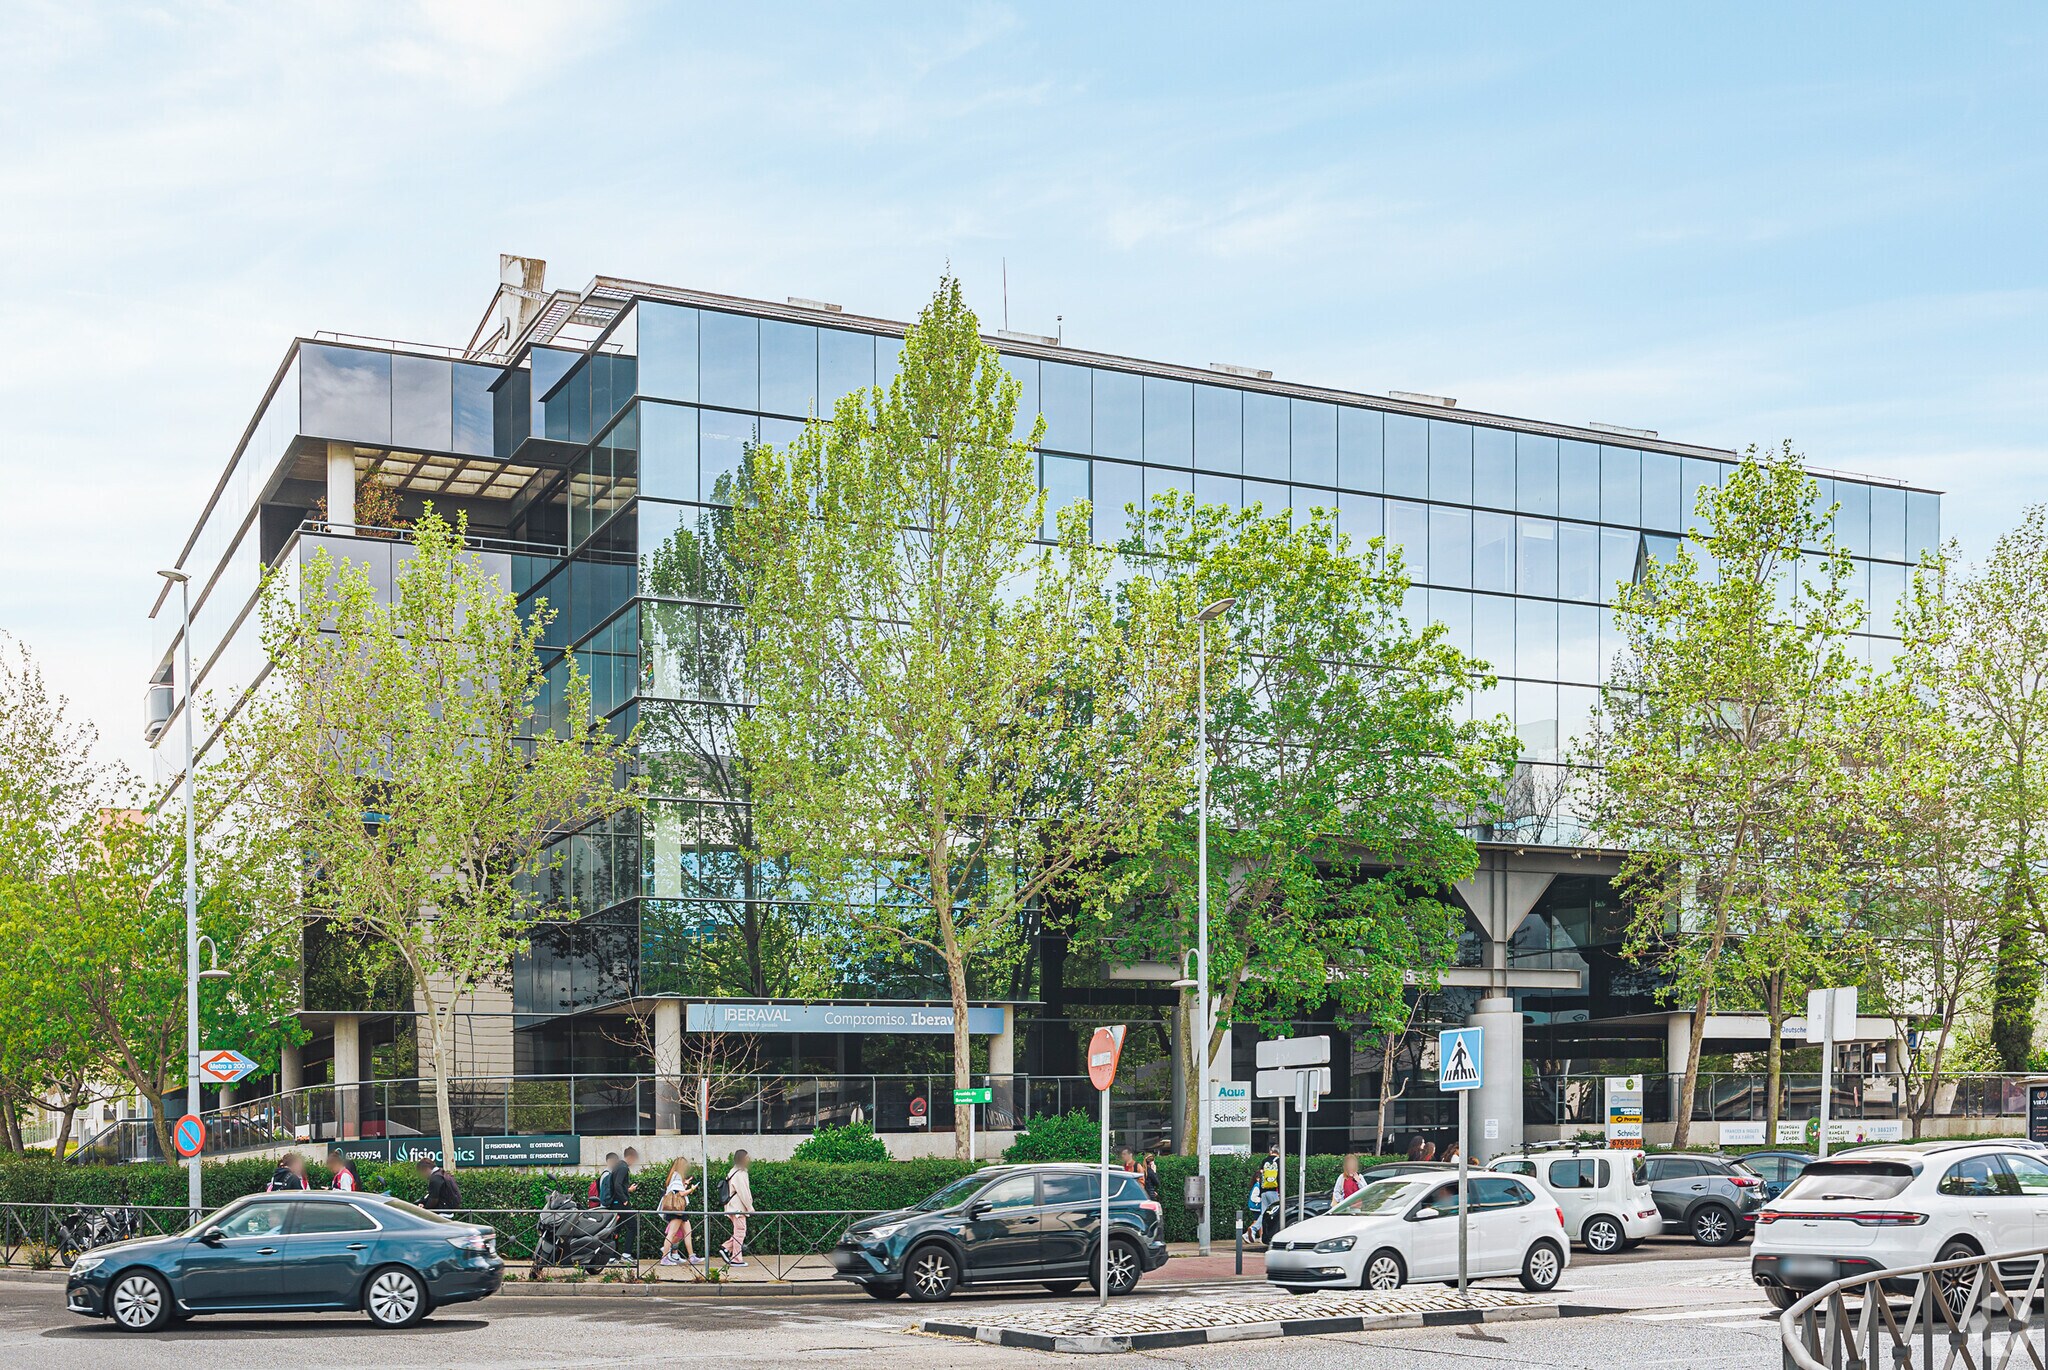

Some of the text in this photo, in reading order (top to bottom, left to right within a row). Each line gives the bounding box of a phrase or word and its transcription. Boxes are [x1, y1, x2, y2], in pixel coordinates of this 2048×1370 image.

[724, 1008, 791, 1022] IBERAVAL
[824, 1012, 954, 1028] Compromiso. Iberav
[1218, 1087, 1246, 1097] Aqua
[345, 1151, 382, 1160] 637559754
